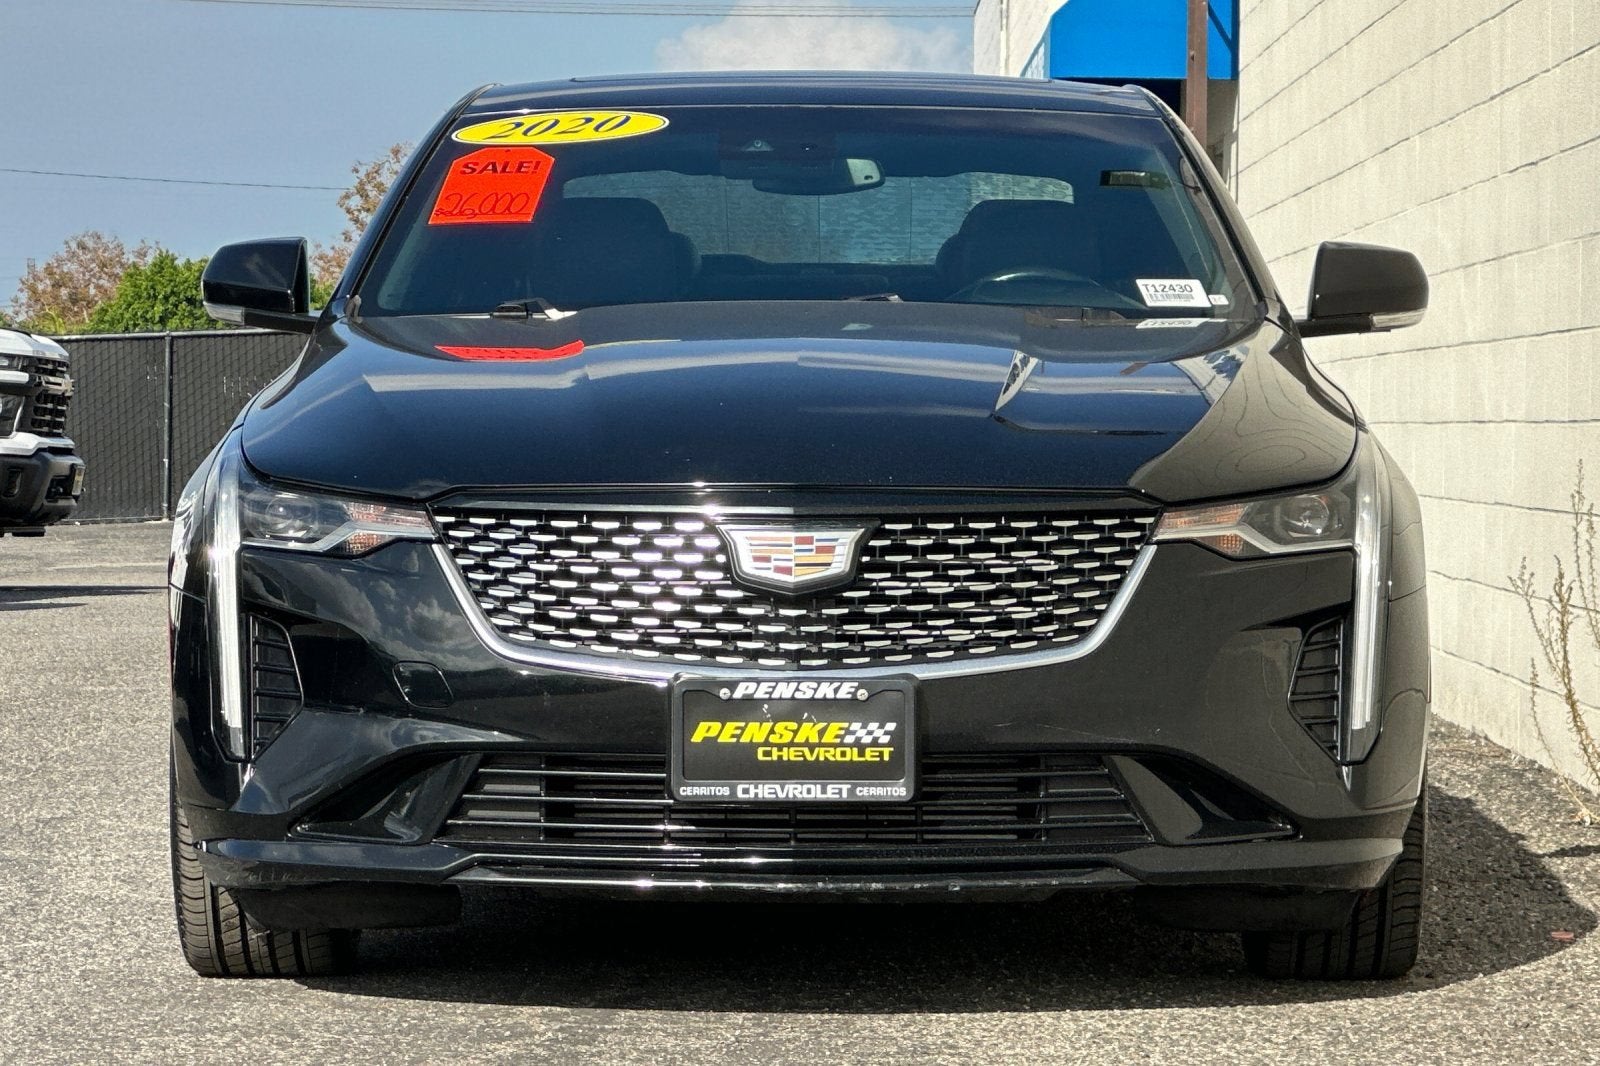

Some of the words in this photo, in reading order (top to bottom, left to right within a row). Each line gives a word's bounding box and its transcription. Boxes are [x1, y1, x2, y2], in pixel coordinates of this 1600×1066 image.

[485, 115, 632, 141] 2020
[459, 160, 542, 175] SALE!
[1142, 283, 1193, 293] T12430
[732, 681, 859, 699] PENSKE
[690, 721, 849, 743] PENSKE
[757, 747, 894, 761] CHEVROLET
[680, 786, 730, 795] CERRITOS
[737, 784, 851, 798] CHEVROLET
[856, 786, 907, 796] CERRITOS
